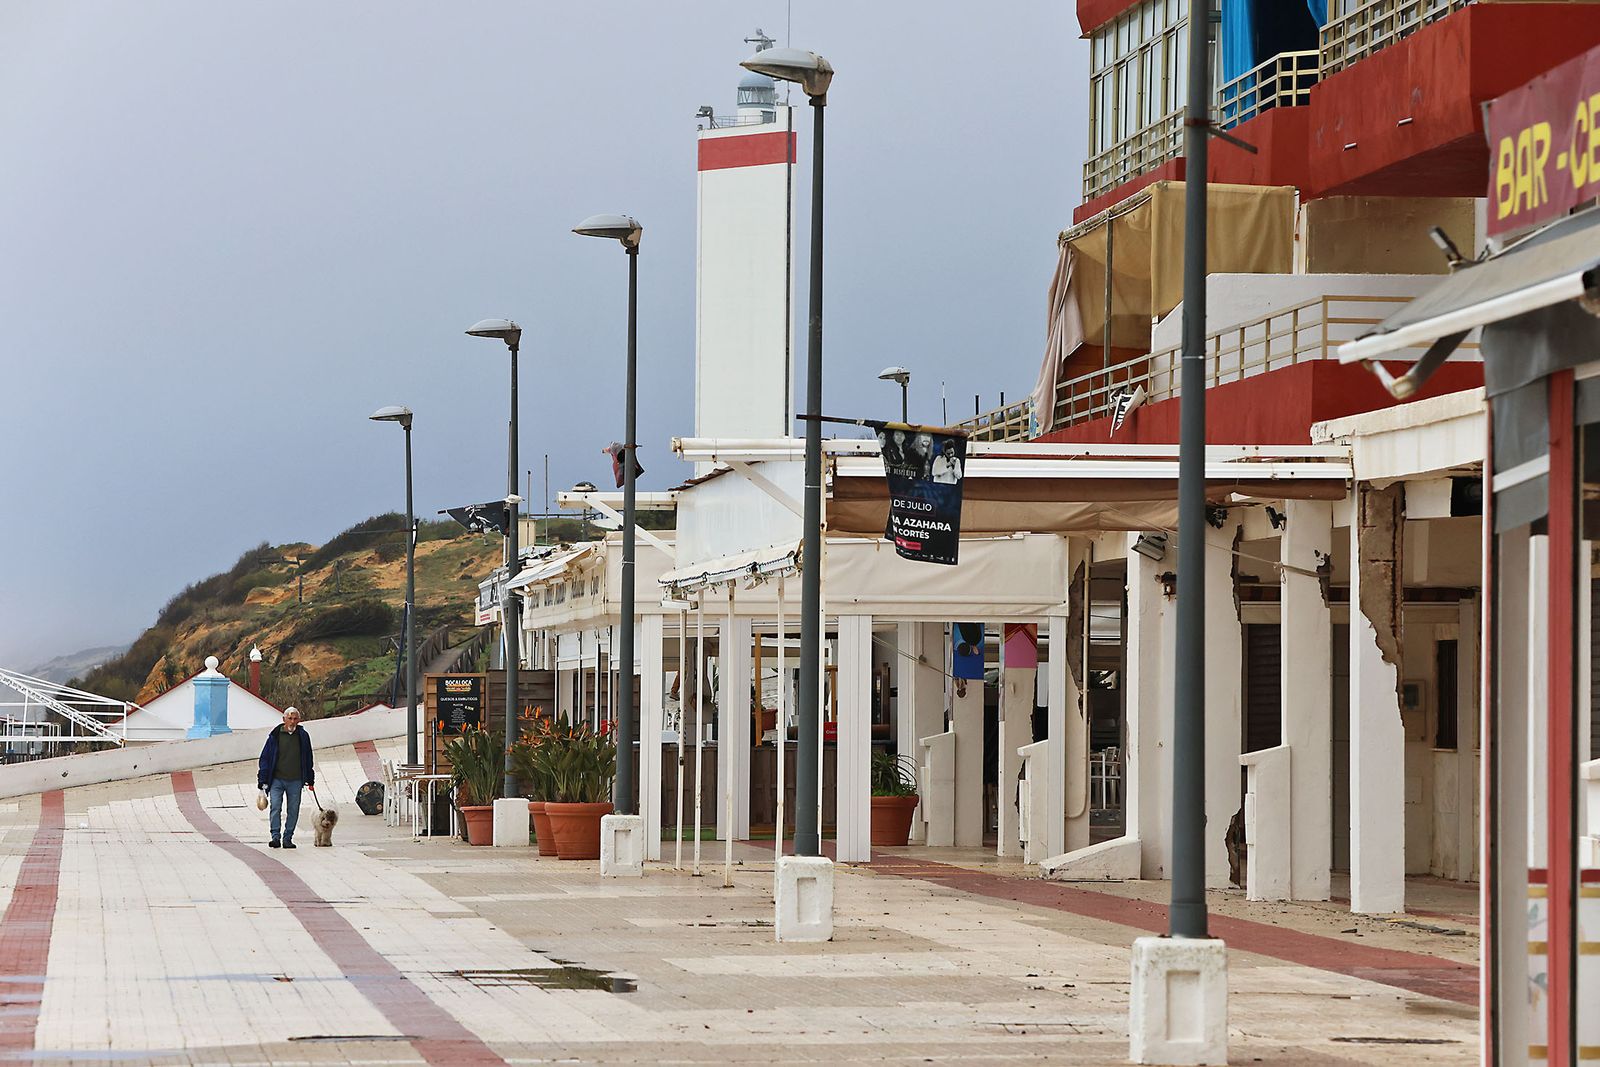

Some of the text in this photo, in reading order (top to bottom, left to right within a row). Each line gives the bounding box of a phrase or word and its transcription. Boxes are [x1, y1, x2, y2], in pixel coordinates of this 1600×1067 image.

[1497, 121, 1551, 220] BAR
[893, 499, 932, 511] DE JULIO
[903, 518, 952, 532] AZAHARA
[898, 528, 930, 539] CORTÉS
